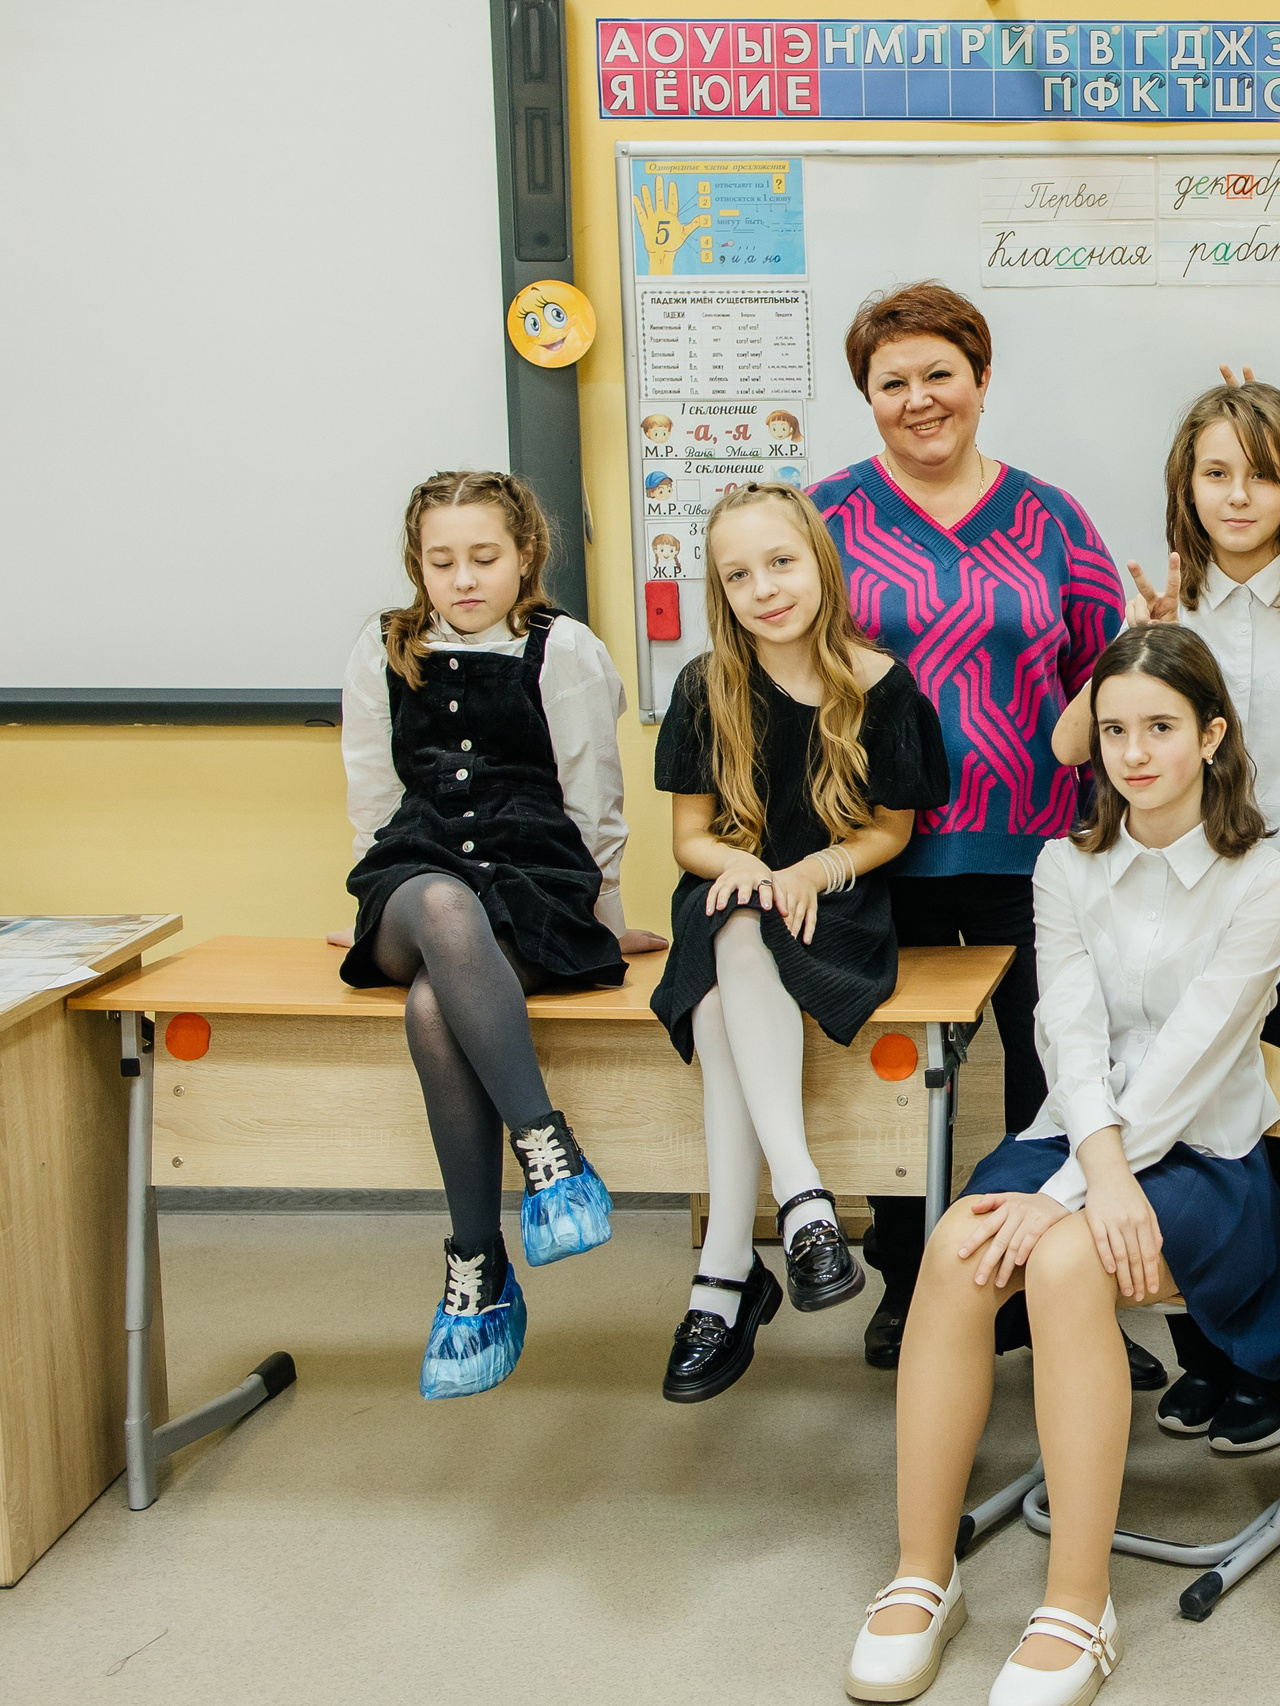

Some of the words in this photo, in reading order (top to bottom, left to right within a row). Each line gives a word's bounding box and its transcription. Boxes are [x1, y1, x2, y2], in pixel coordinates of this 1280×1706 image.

[604, 28, 639, 62] А
[647, 28, 684, 63] О
[693, 28, 724, 62] У
[738, 28, 771, 62] Ы
[783, 27, 811, 63] Э
[825, 28, 854, 63] Н
[864, 28, 904, 63] М
[911, 28, 943, 63] Л
[962, 28, 986, 63] Р
[1002, 25, 1032, 65] Й
[1045, 29, 1070, 65] Б
[1089, 30, 1113, 65] В
[1134, 30, 1159, 65] Г
[1171, 30, 1205, 70] Д
[1213, 30, 1253, 66] Ж
[649, 163, 699, 172] Однородные
[704, 163, 728, 172] члены
[733, 163, 787, 172] предложения
[768, 196, 793, 204] слову
[1025, 182, 1109, 219] Первое
[716, 219, 740, 227] могут
[655, 220, 671, 245] 5
[988, 230, 1153, 269] Классная
[651, 297, 687, 305] ПАДЕЖИ
[716, 296, 800, 306] СУЩЕСТВИТЕЛЬНЫХ
[663, 311, 686, 319] ПАДЕЖИ
[681, 403, 687, 415] 1
[689, 404, 758, 416] склонение
[725, 424, 753, 441] -я
[645, 446, 679, 458] М.Р.
[685, 446, 715, 458] Ваня
[725, 445, 760, 458] Мила
[768, 444, 804, 457] Ж.Р.
[684, 461, 692, 474] 2
[695, 462, 764, 476] склонение
[648, 503, 682, 516] М.Р.
[689, 523, 697, 536] 3
[653, 567, 687, 579] Ж.Р.
